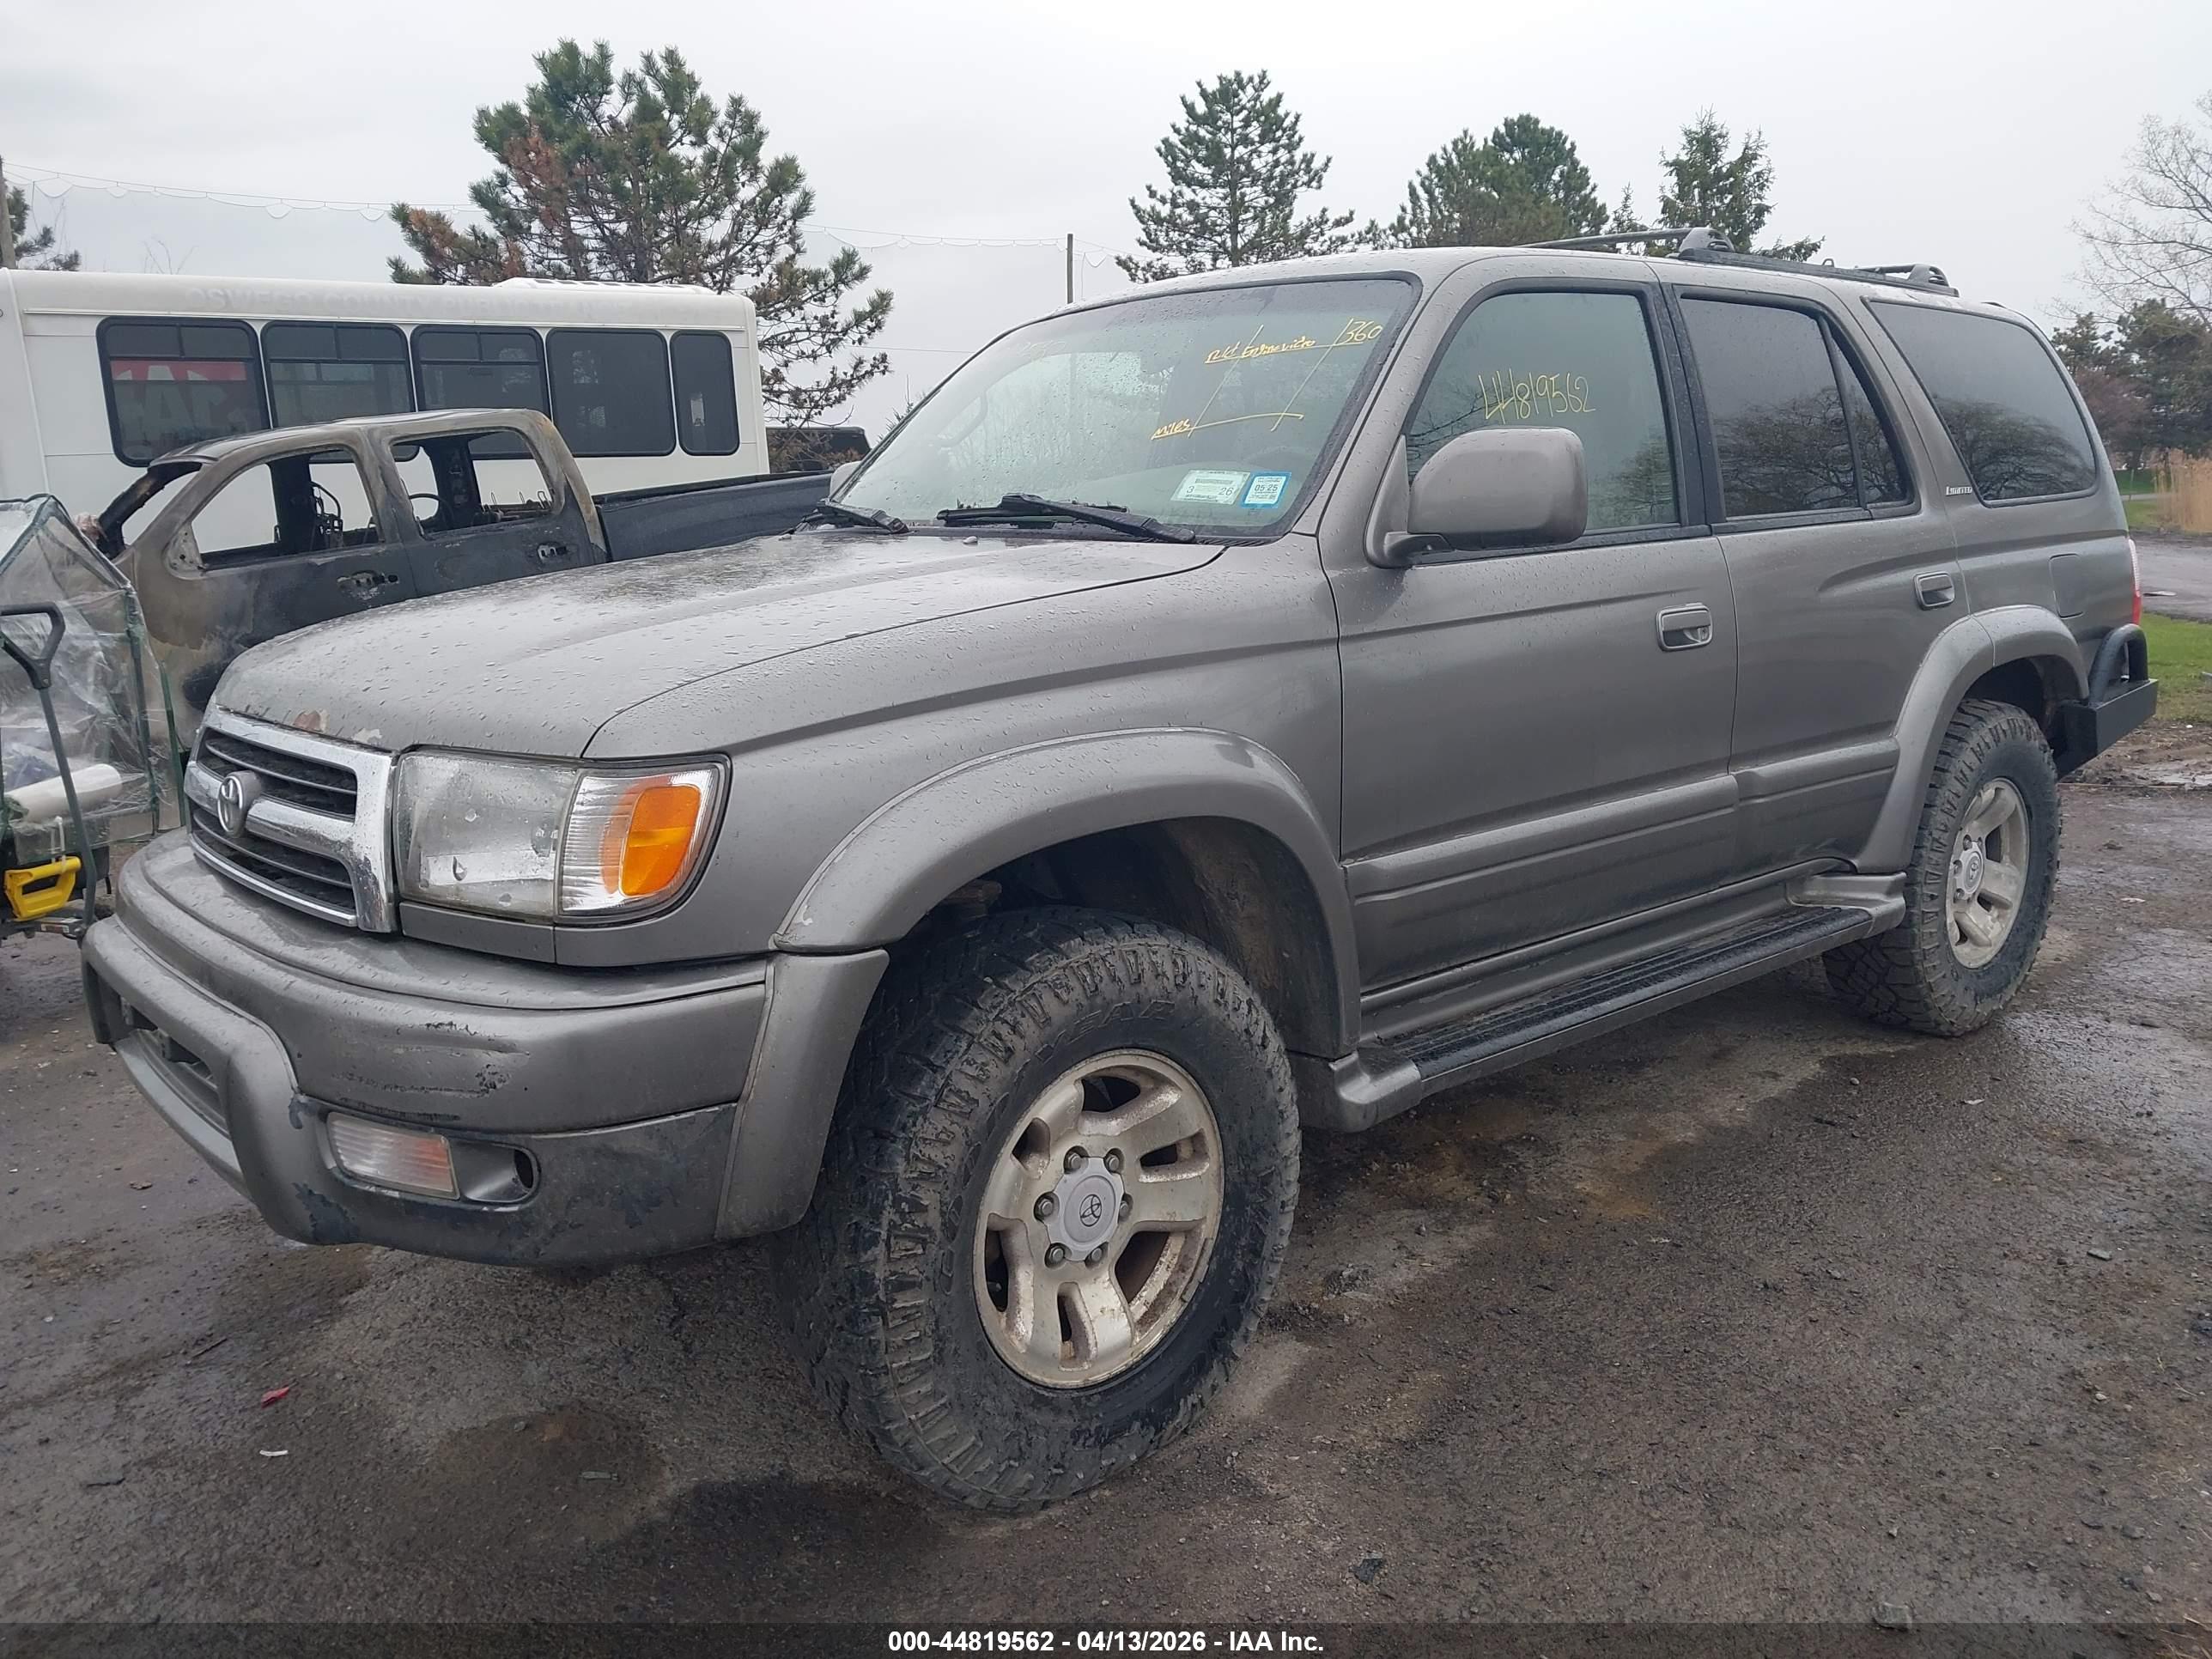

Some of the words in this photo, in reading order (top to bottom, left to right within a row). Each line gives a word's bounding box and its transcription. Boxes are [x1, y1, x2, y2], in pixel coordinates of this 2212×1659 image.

[1346, 320, 1383, 343] 360
[1478, 368, 1596, 424] 44819562
[1153, 418, 1190, 438] miles
[1187, 485, 1195, 494] 3
[1218, 487, 1234, 496] 26
